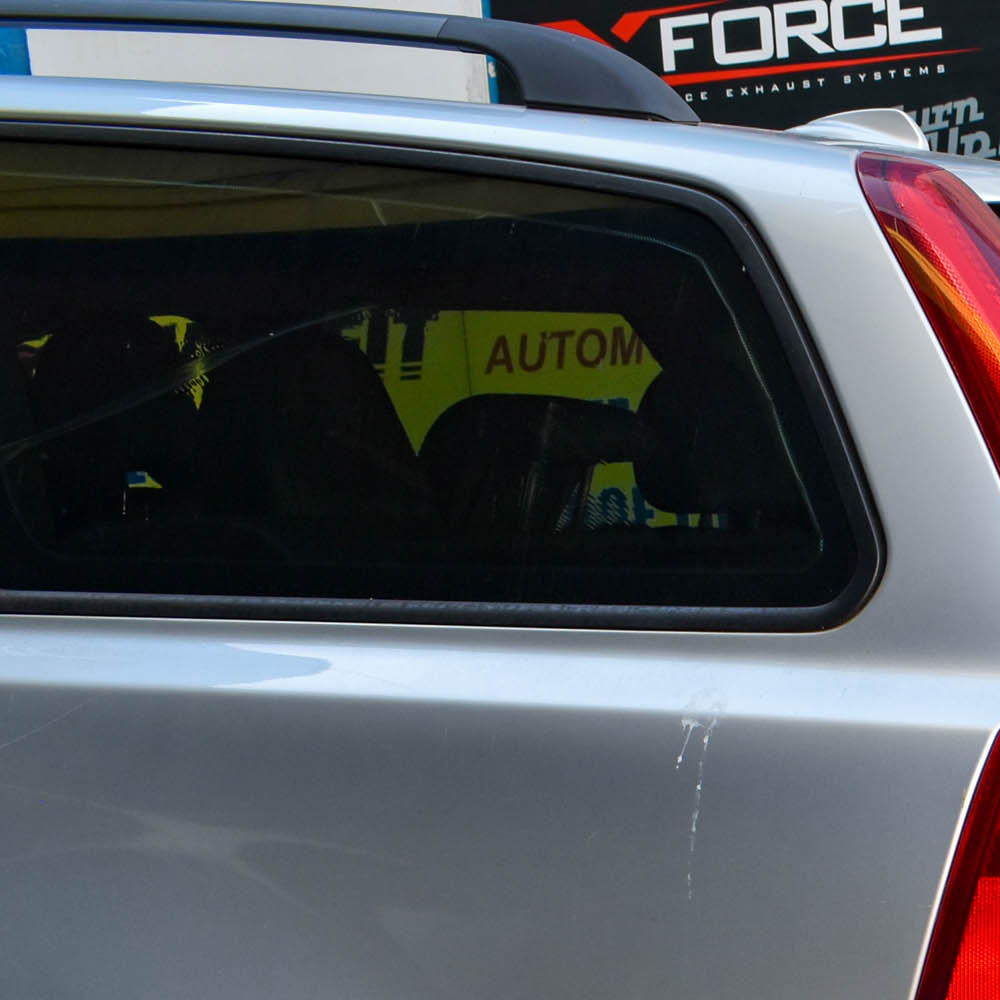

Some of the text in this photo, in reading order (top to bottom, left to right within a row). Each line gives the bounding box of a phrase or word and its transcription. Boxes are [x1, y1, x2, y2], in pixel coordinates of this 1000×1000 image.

[684, 64, 946, 102] CE EXHAUST SYSTEMS
[891, 97, 984, 132] urn
